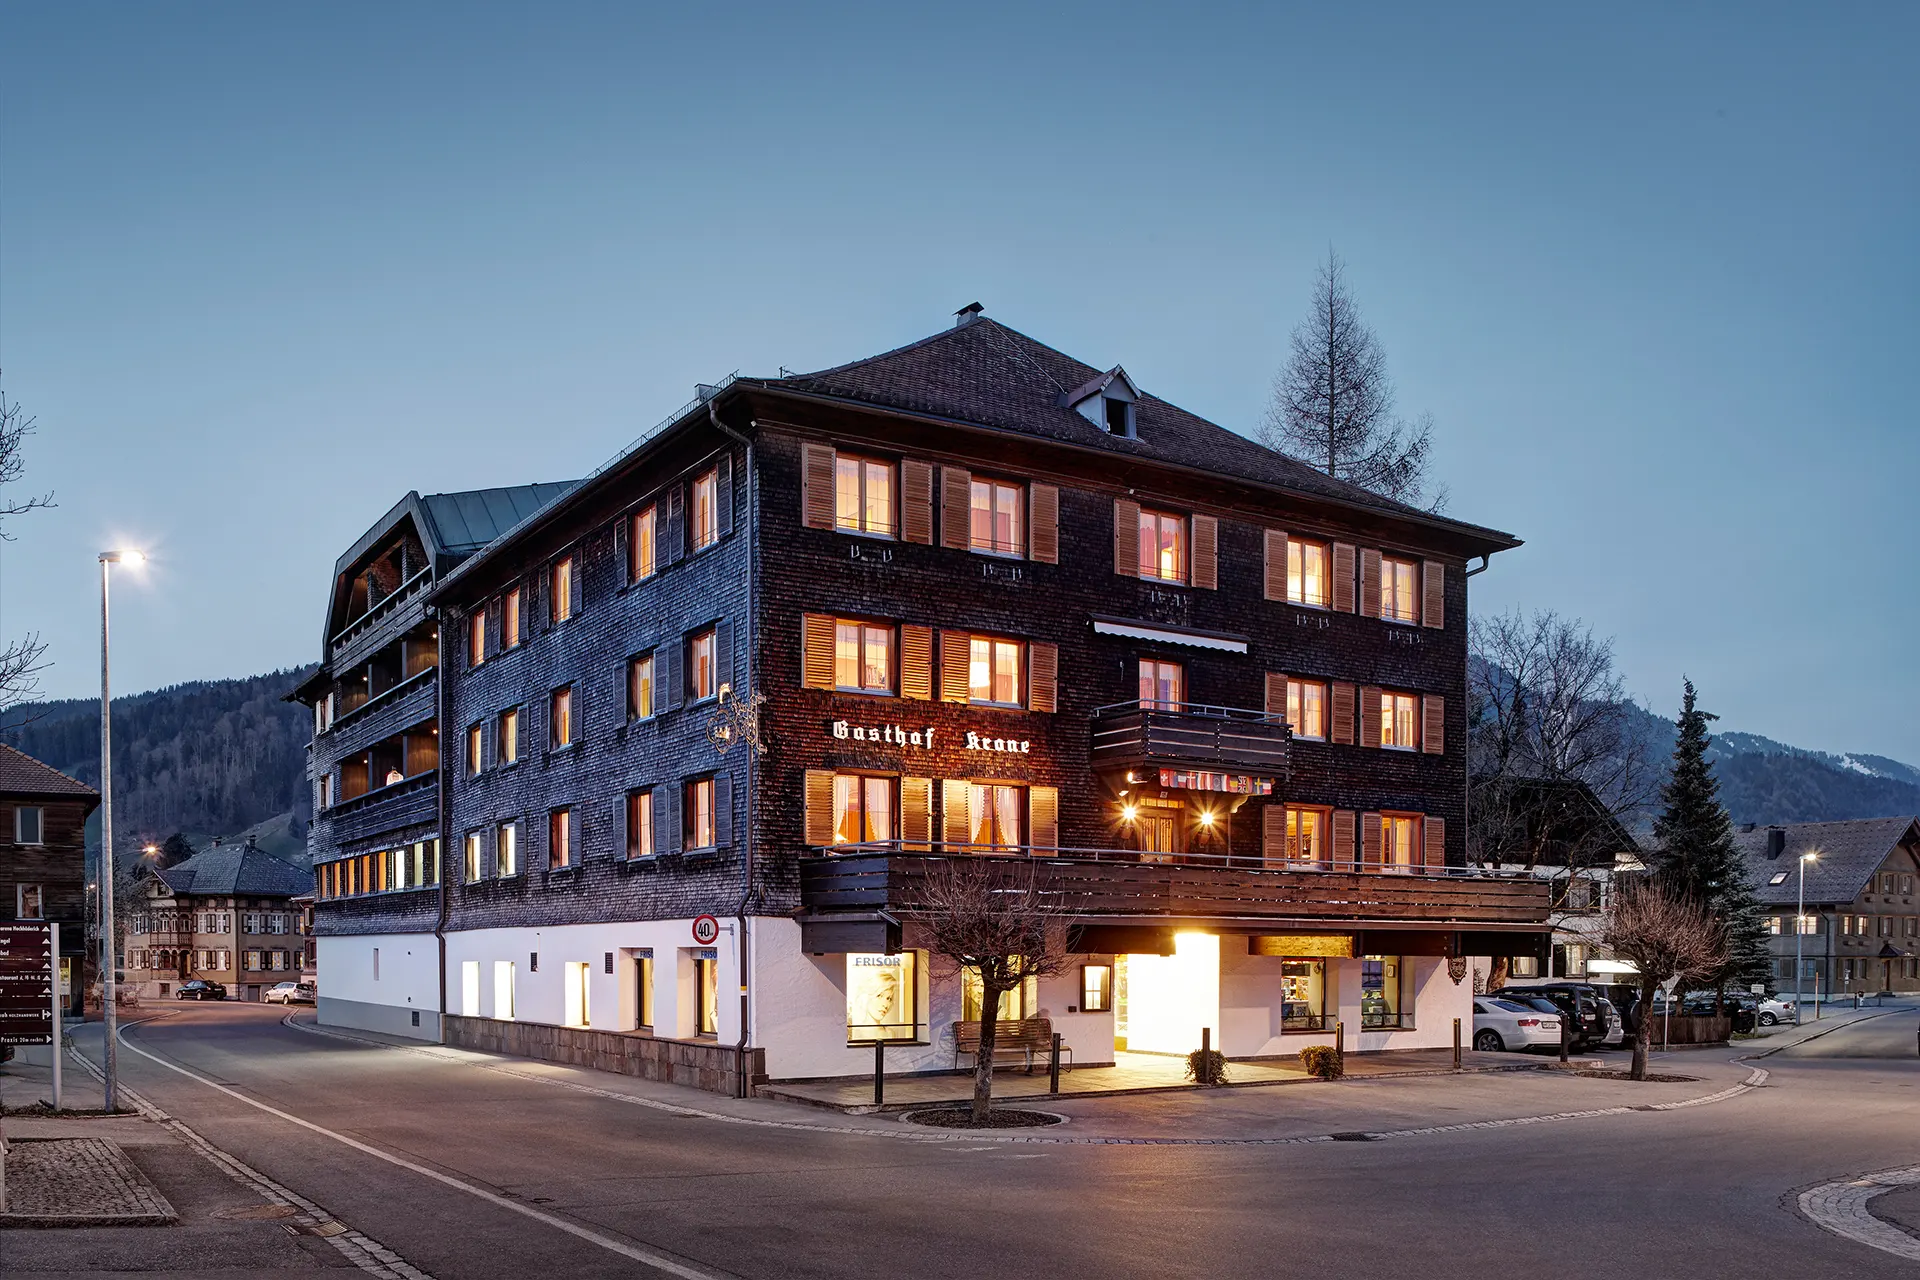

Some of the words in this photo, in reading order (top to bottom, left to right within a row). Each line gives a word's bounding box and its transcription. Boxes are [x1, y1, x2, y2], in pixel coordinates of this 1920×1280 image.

[833, 720, 935, 749] Gasthof
[966, 731, 1030, 753] Krone
[698, 923, 710, 937] 40
